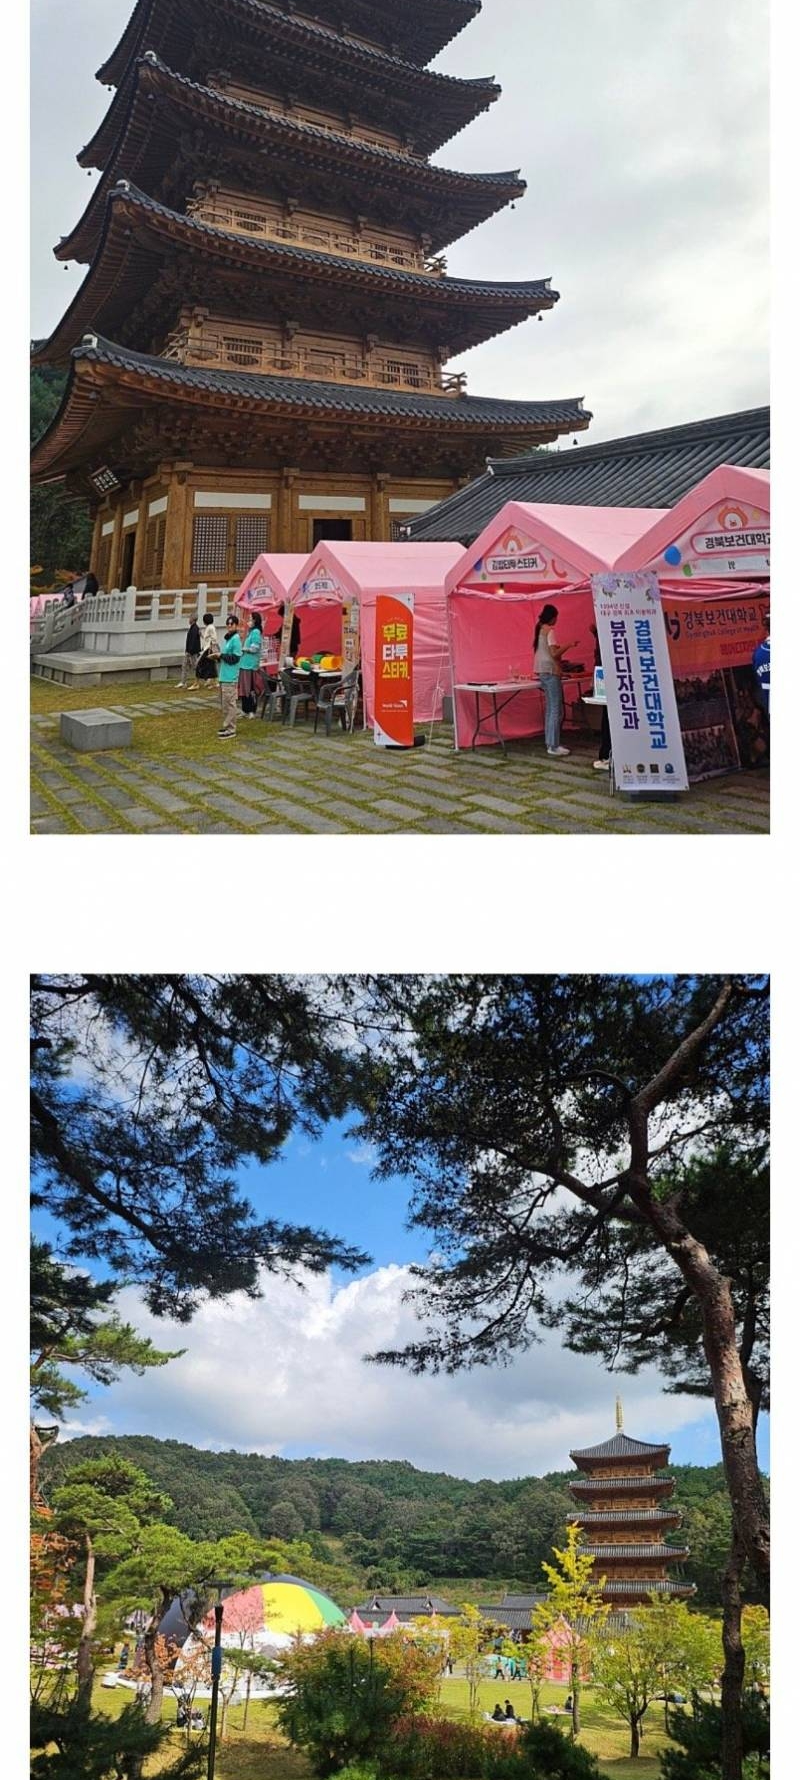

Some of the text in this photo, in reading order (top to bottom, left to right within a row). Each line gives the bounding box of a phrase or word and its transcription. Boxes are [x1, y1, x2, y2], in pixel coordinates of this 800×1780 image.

[682, 606, 757, 630] 경북보건대학교
[381, 623, 408, 641] 무료
[382, 643, 408, 660] 타투
[610, 620, 640, 730] 뷰티디자인과
[634, 619, 668, 750] 경북보건대학교
